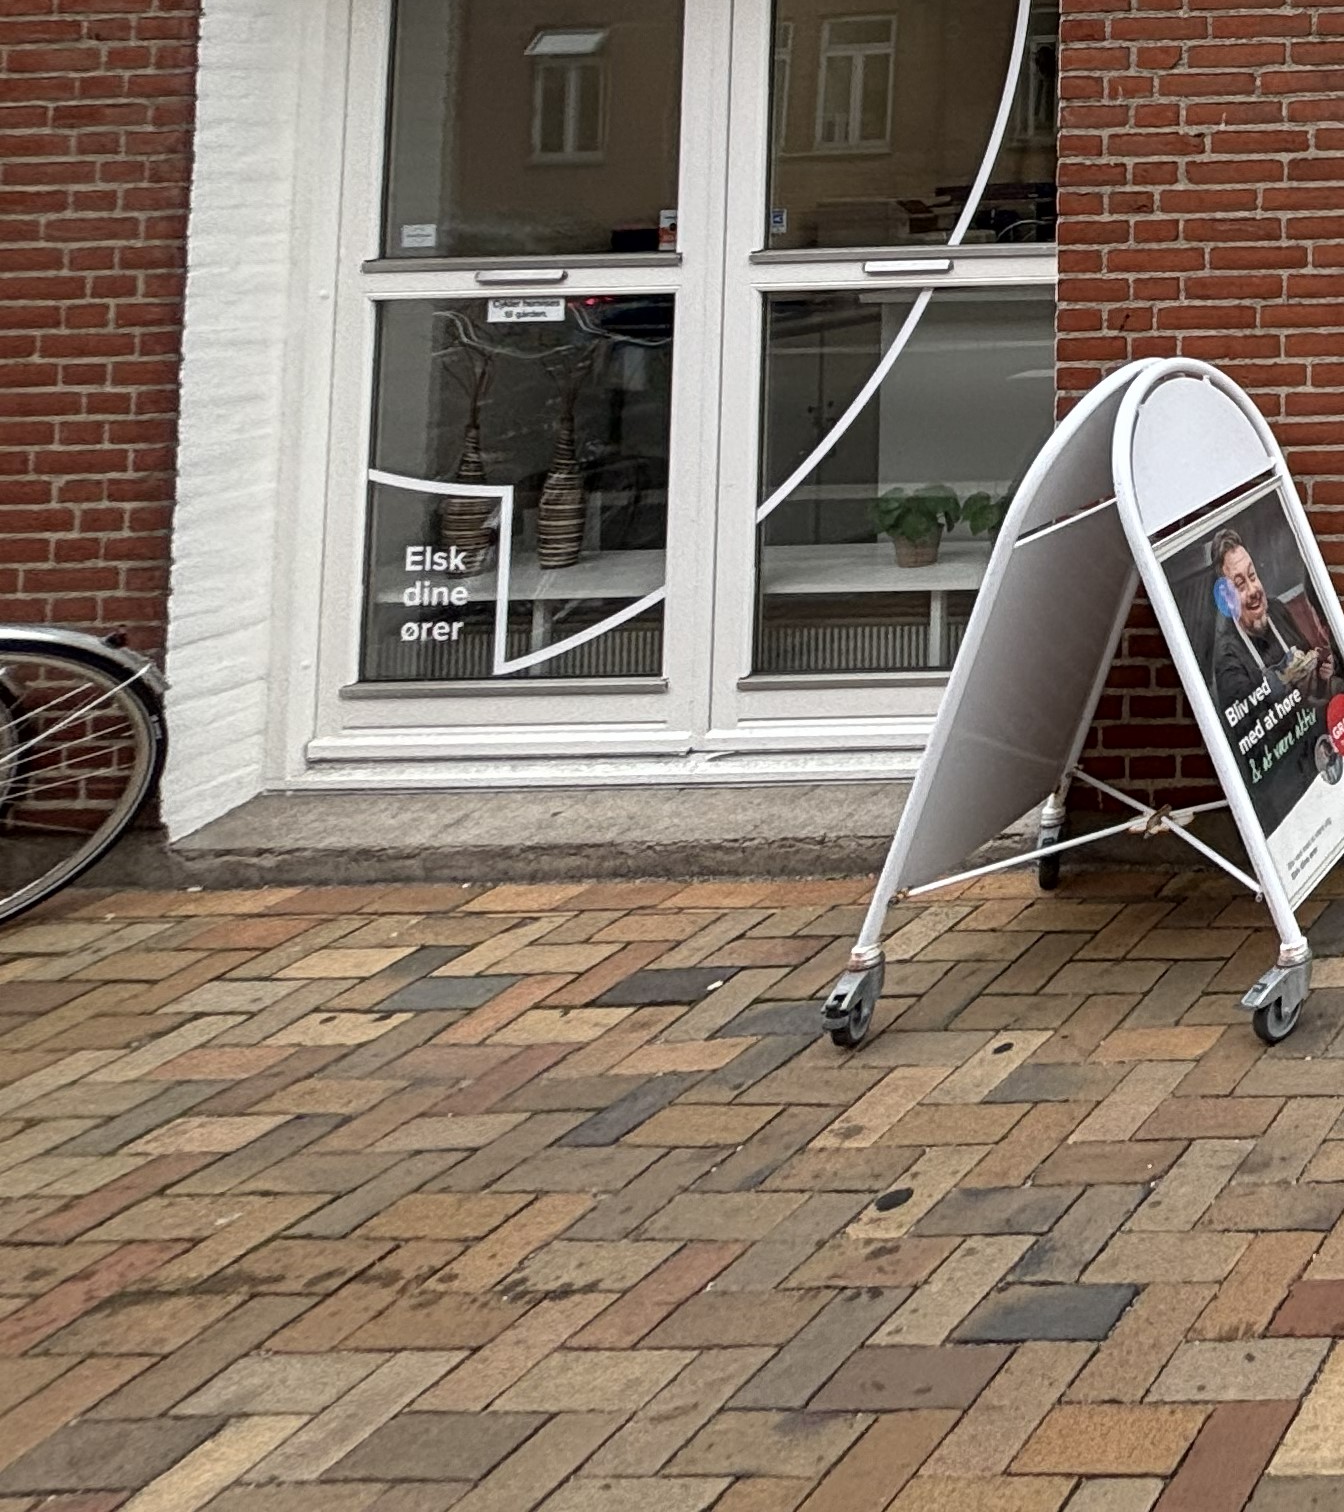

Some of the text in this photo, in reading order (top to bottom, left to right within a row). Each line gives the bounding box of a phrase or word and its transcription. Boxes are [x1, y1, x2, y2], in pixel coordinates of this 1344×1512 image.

[405, 545, 467, 572] Elsk
[403, 580, 468, 607] dine
[400, 621, 464, 641] ører
[1224, 676, 1271, 727] Bliv ved
[1238, 719, 1265, 755] med
[1263, 708, 1278, 731] at
